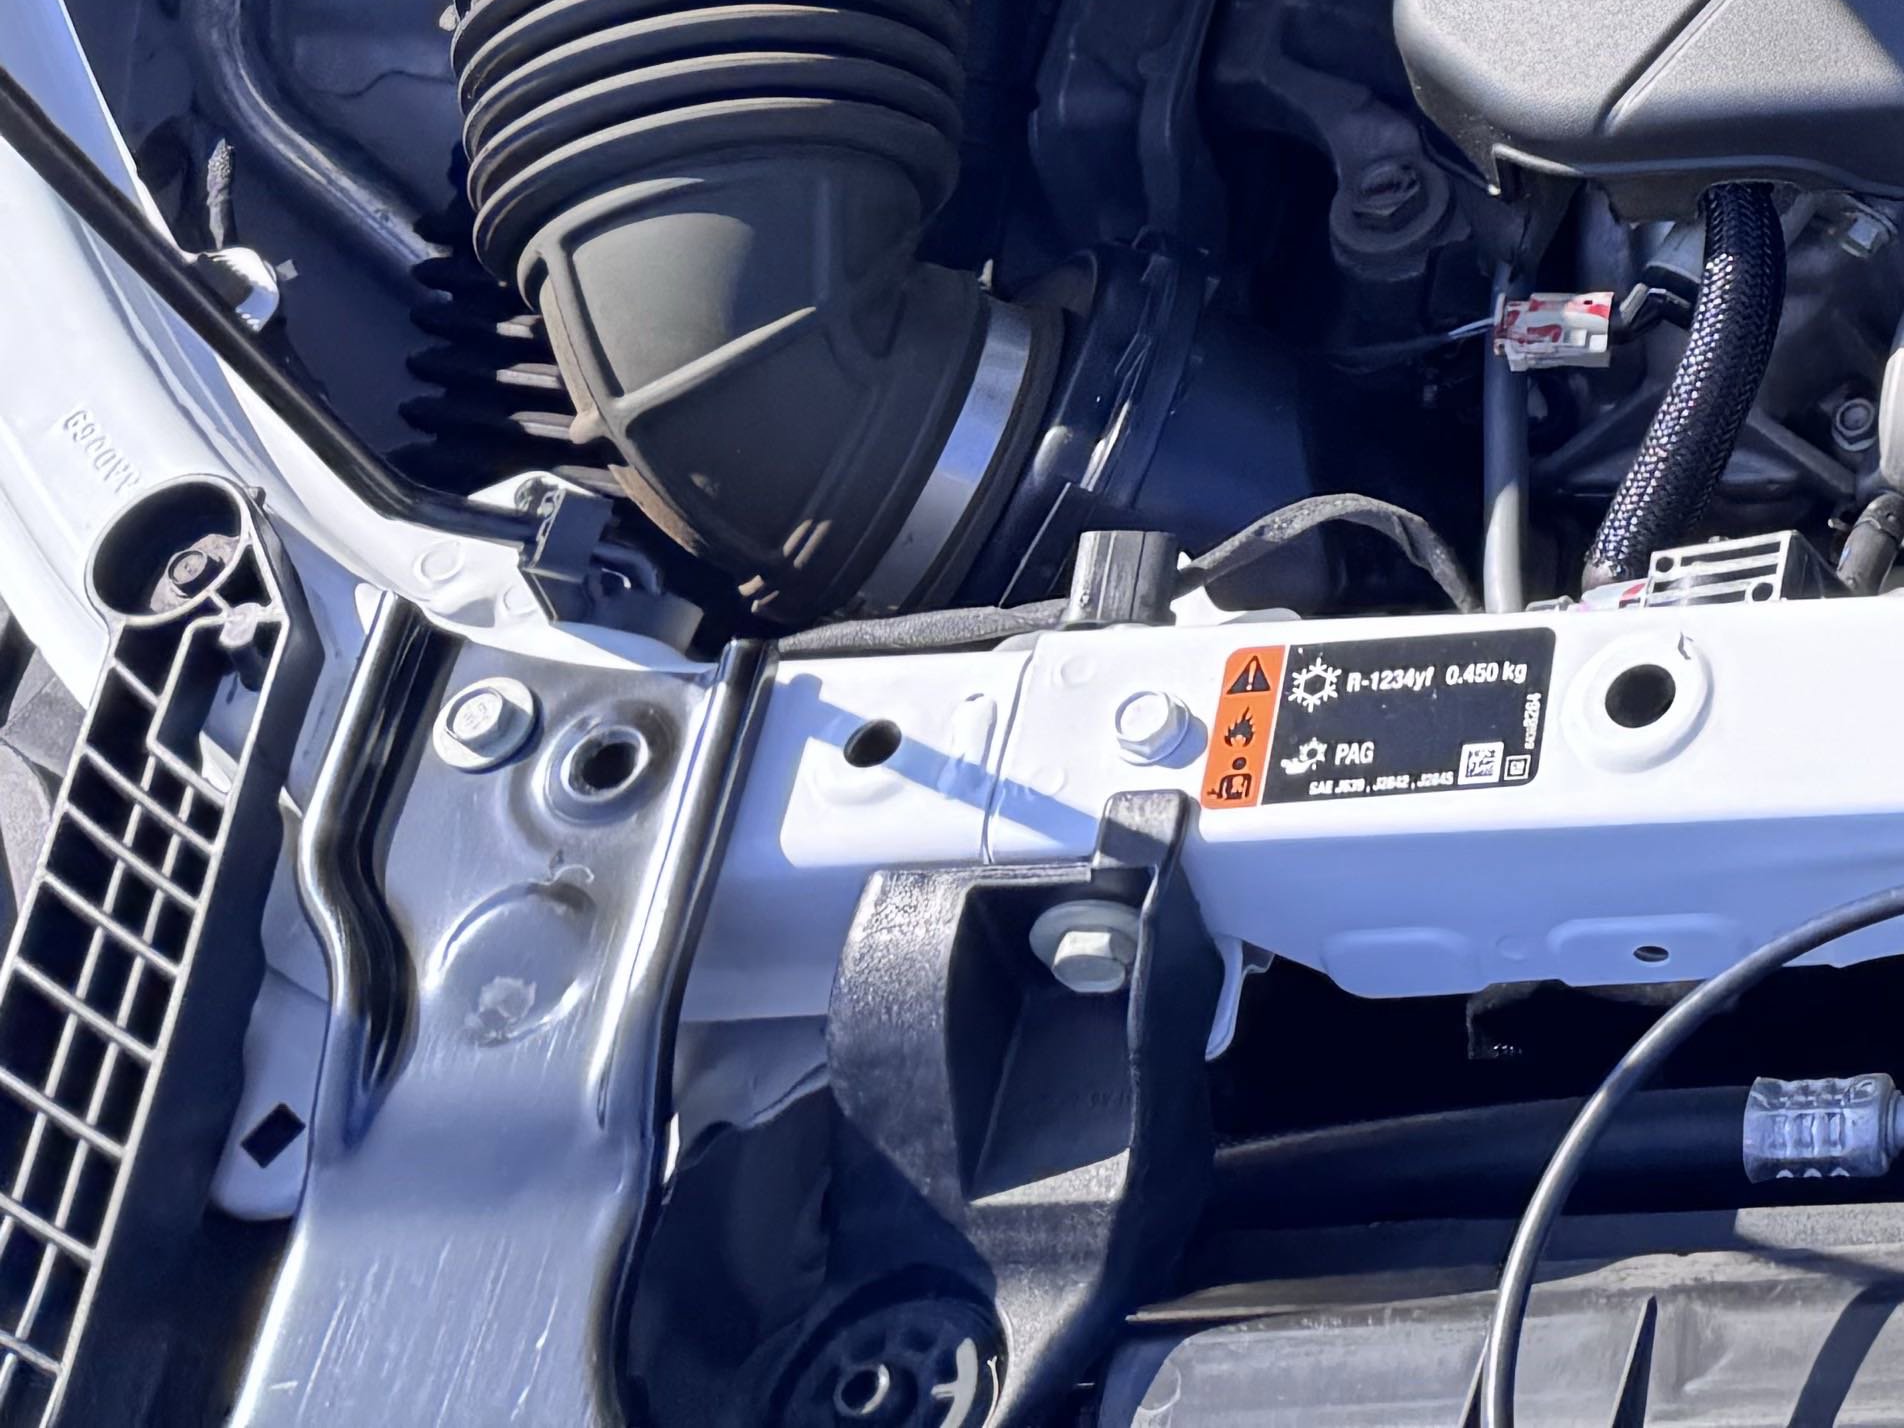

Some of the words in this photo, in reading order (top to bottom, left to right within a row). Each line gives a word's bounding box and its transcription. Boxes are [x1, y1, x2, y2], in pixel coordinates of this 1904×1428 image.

[1346, 667, 1435, 692] R-1234yf
[1445, 662, 1499, 685] 0.450
[1503, 660, 1528, 685] kg
[1334, 741, 1375, 765] PAG
[1309, 780, 1333, 795] SAE
